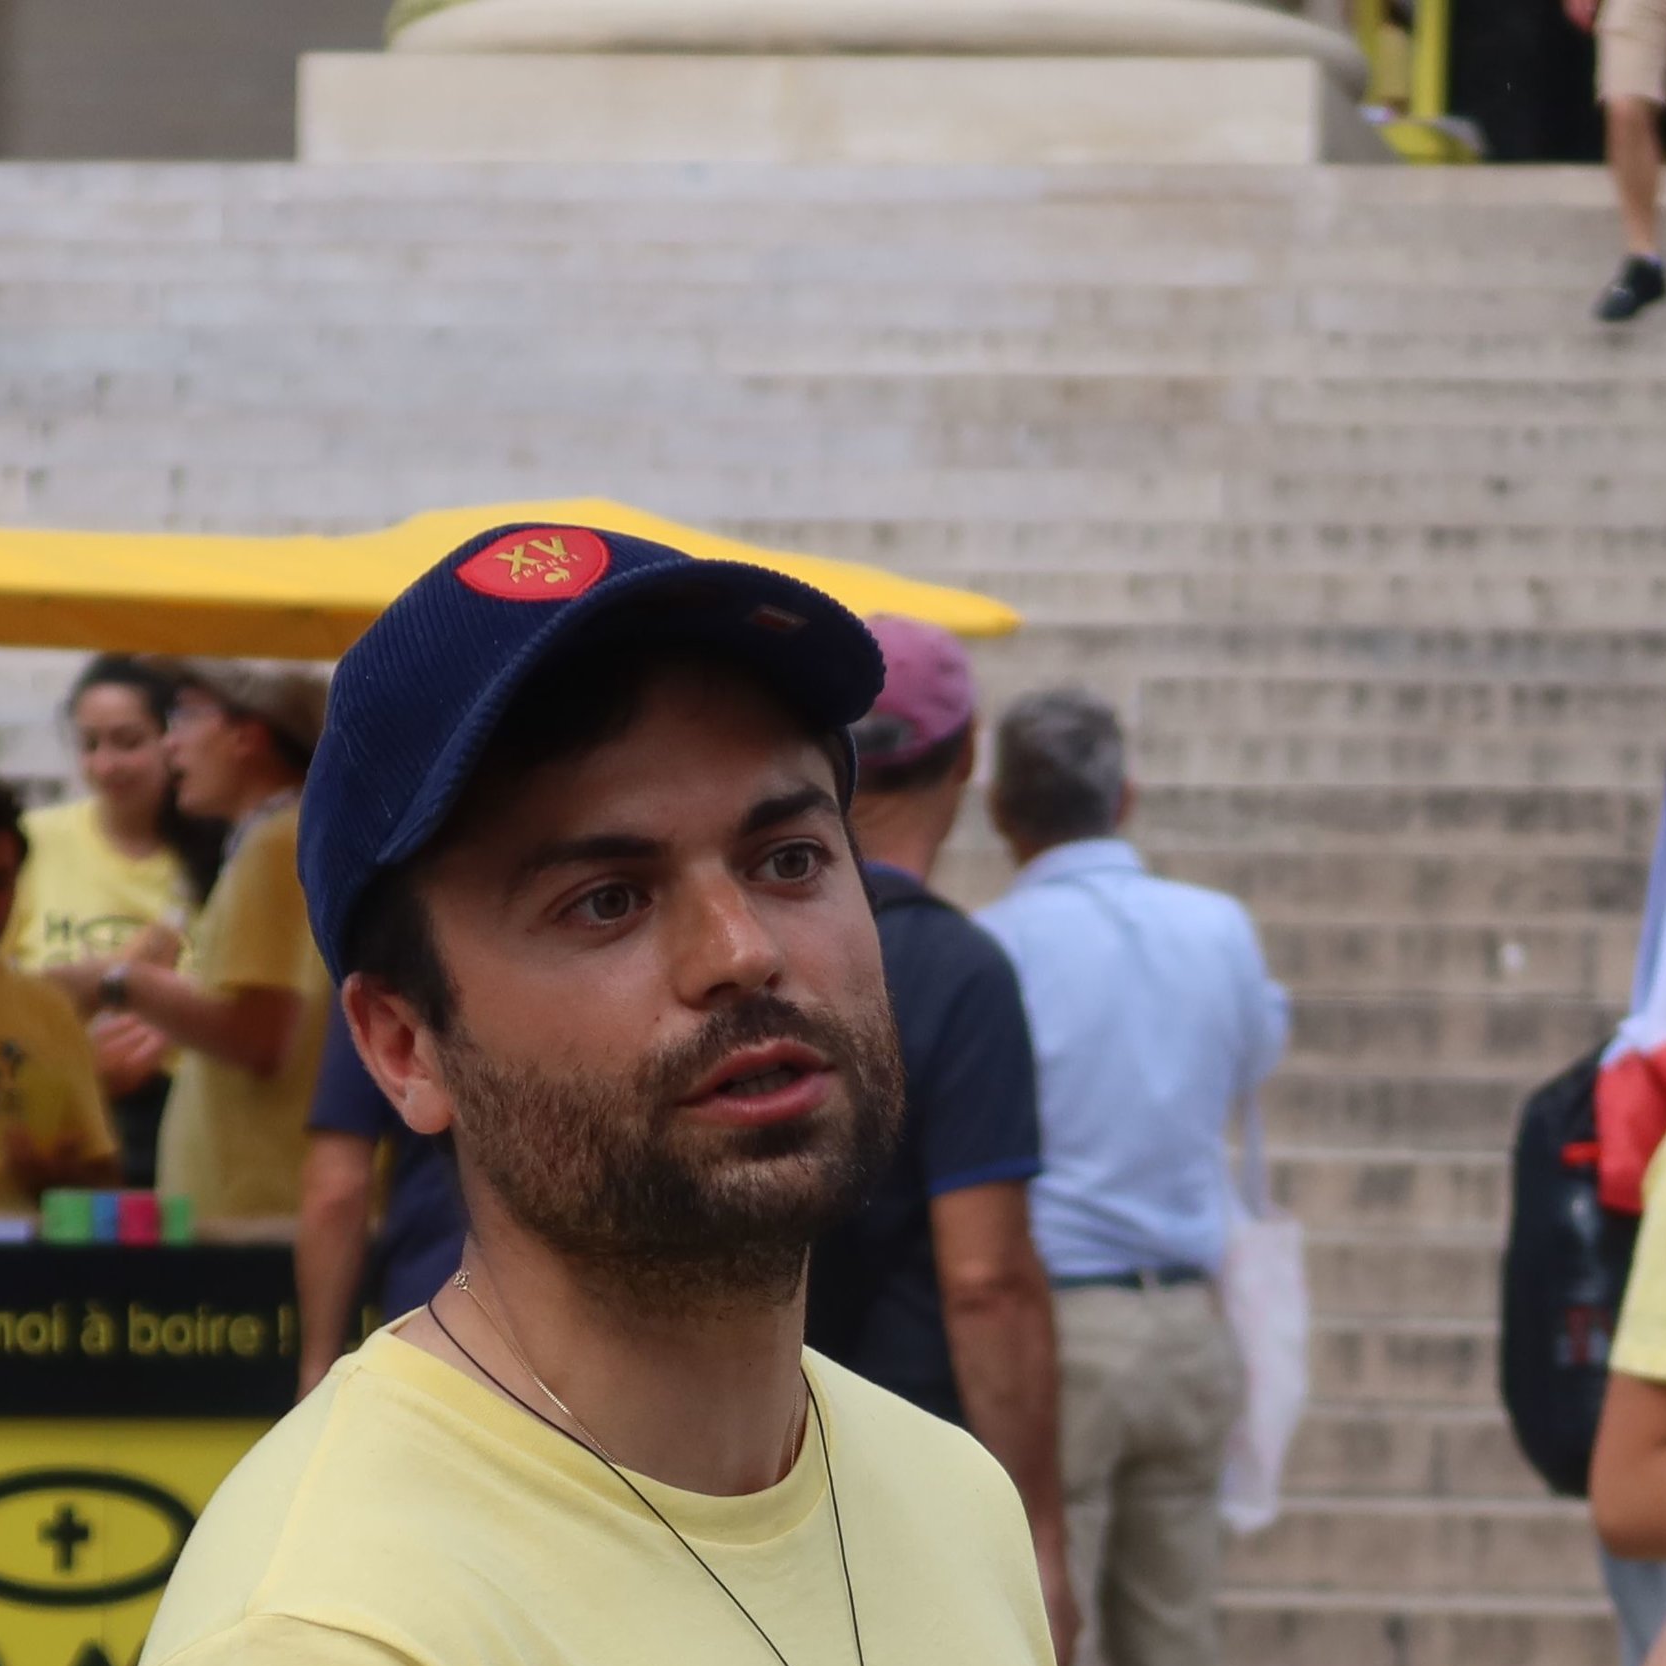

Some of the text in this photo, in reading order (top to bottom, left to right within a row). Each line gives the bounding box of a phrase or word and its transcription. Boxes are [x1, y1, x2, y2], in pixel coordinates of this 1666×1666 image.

[493, 535, 568, 577] XV
[511, 552, 582, 584] FRANCE
[80, 1303, 112, 1354] à
[126, 1303, 263, 1355] boire
